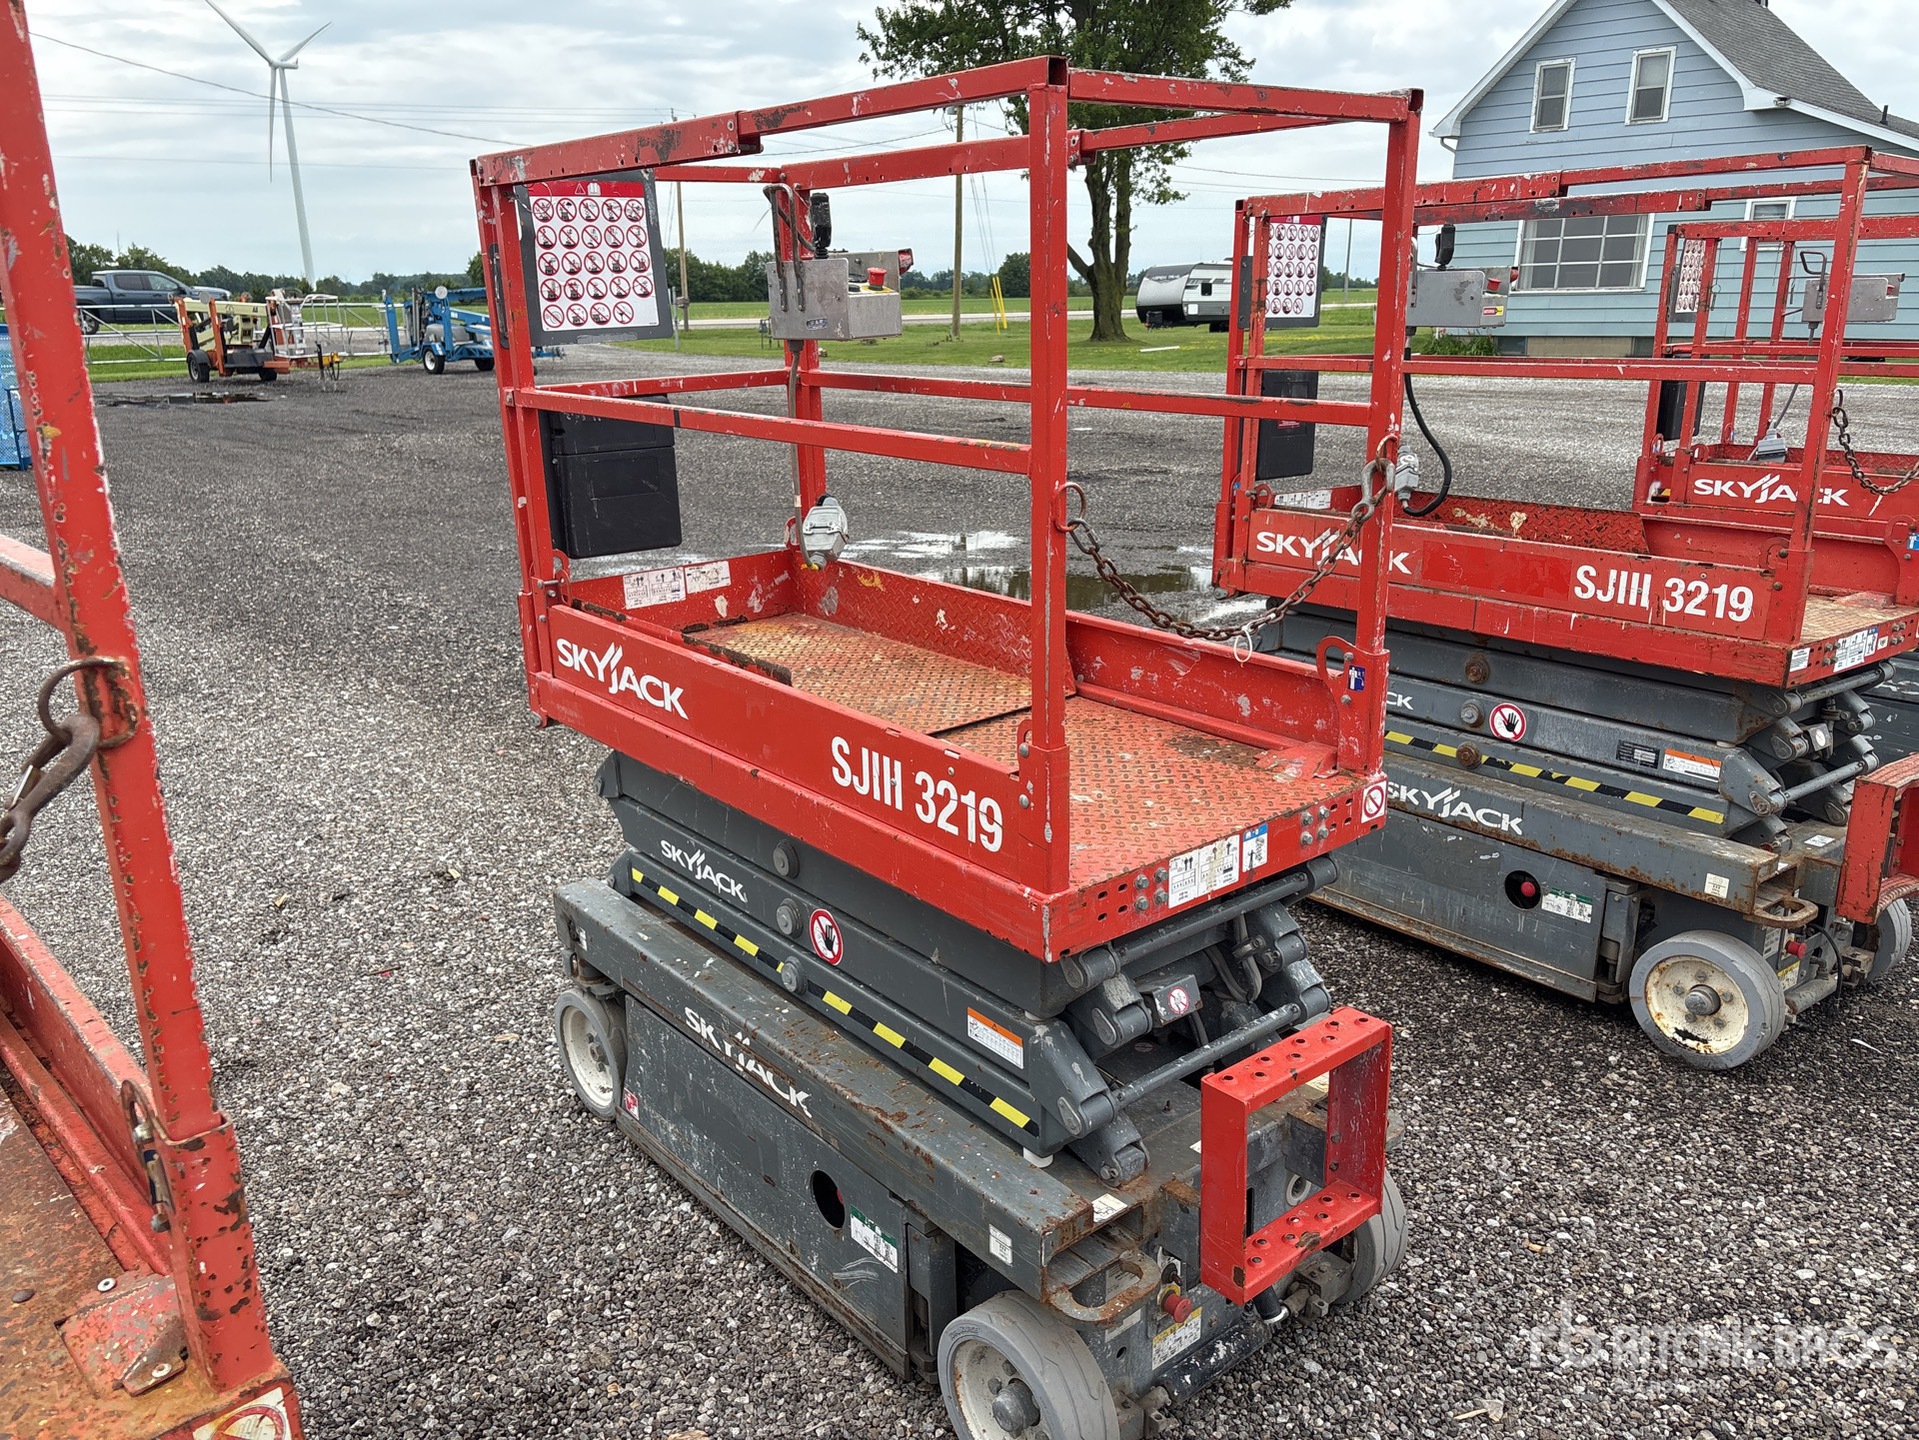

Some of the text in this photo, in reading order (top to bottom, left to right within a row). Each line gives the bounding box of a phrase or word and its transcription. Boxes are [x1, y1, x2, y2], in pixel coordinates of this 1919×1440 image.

[1693, 473, 1850, 507] SKYJAK
[1256, 527, 1412, 575] SKYJAK
[1662, 577, 1754, 622] 3219
[556, 638, 689, 720] SKYJACK
[914, 770, 1004, 853] 3219
[660, 839, 748, 903] SKYJACK
